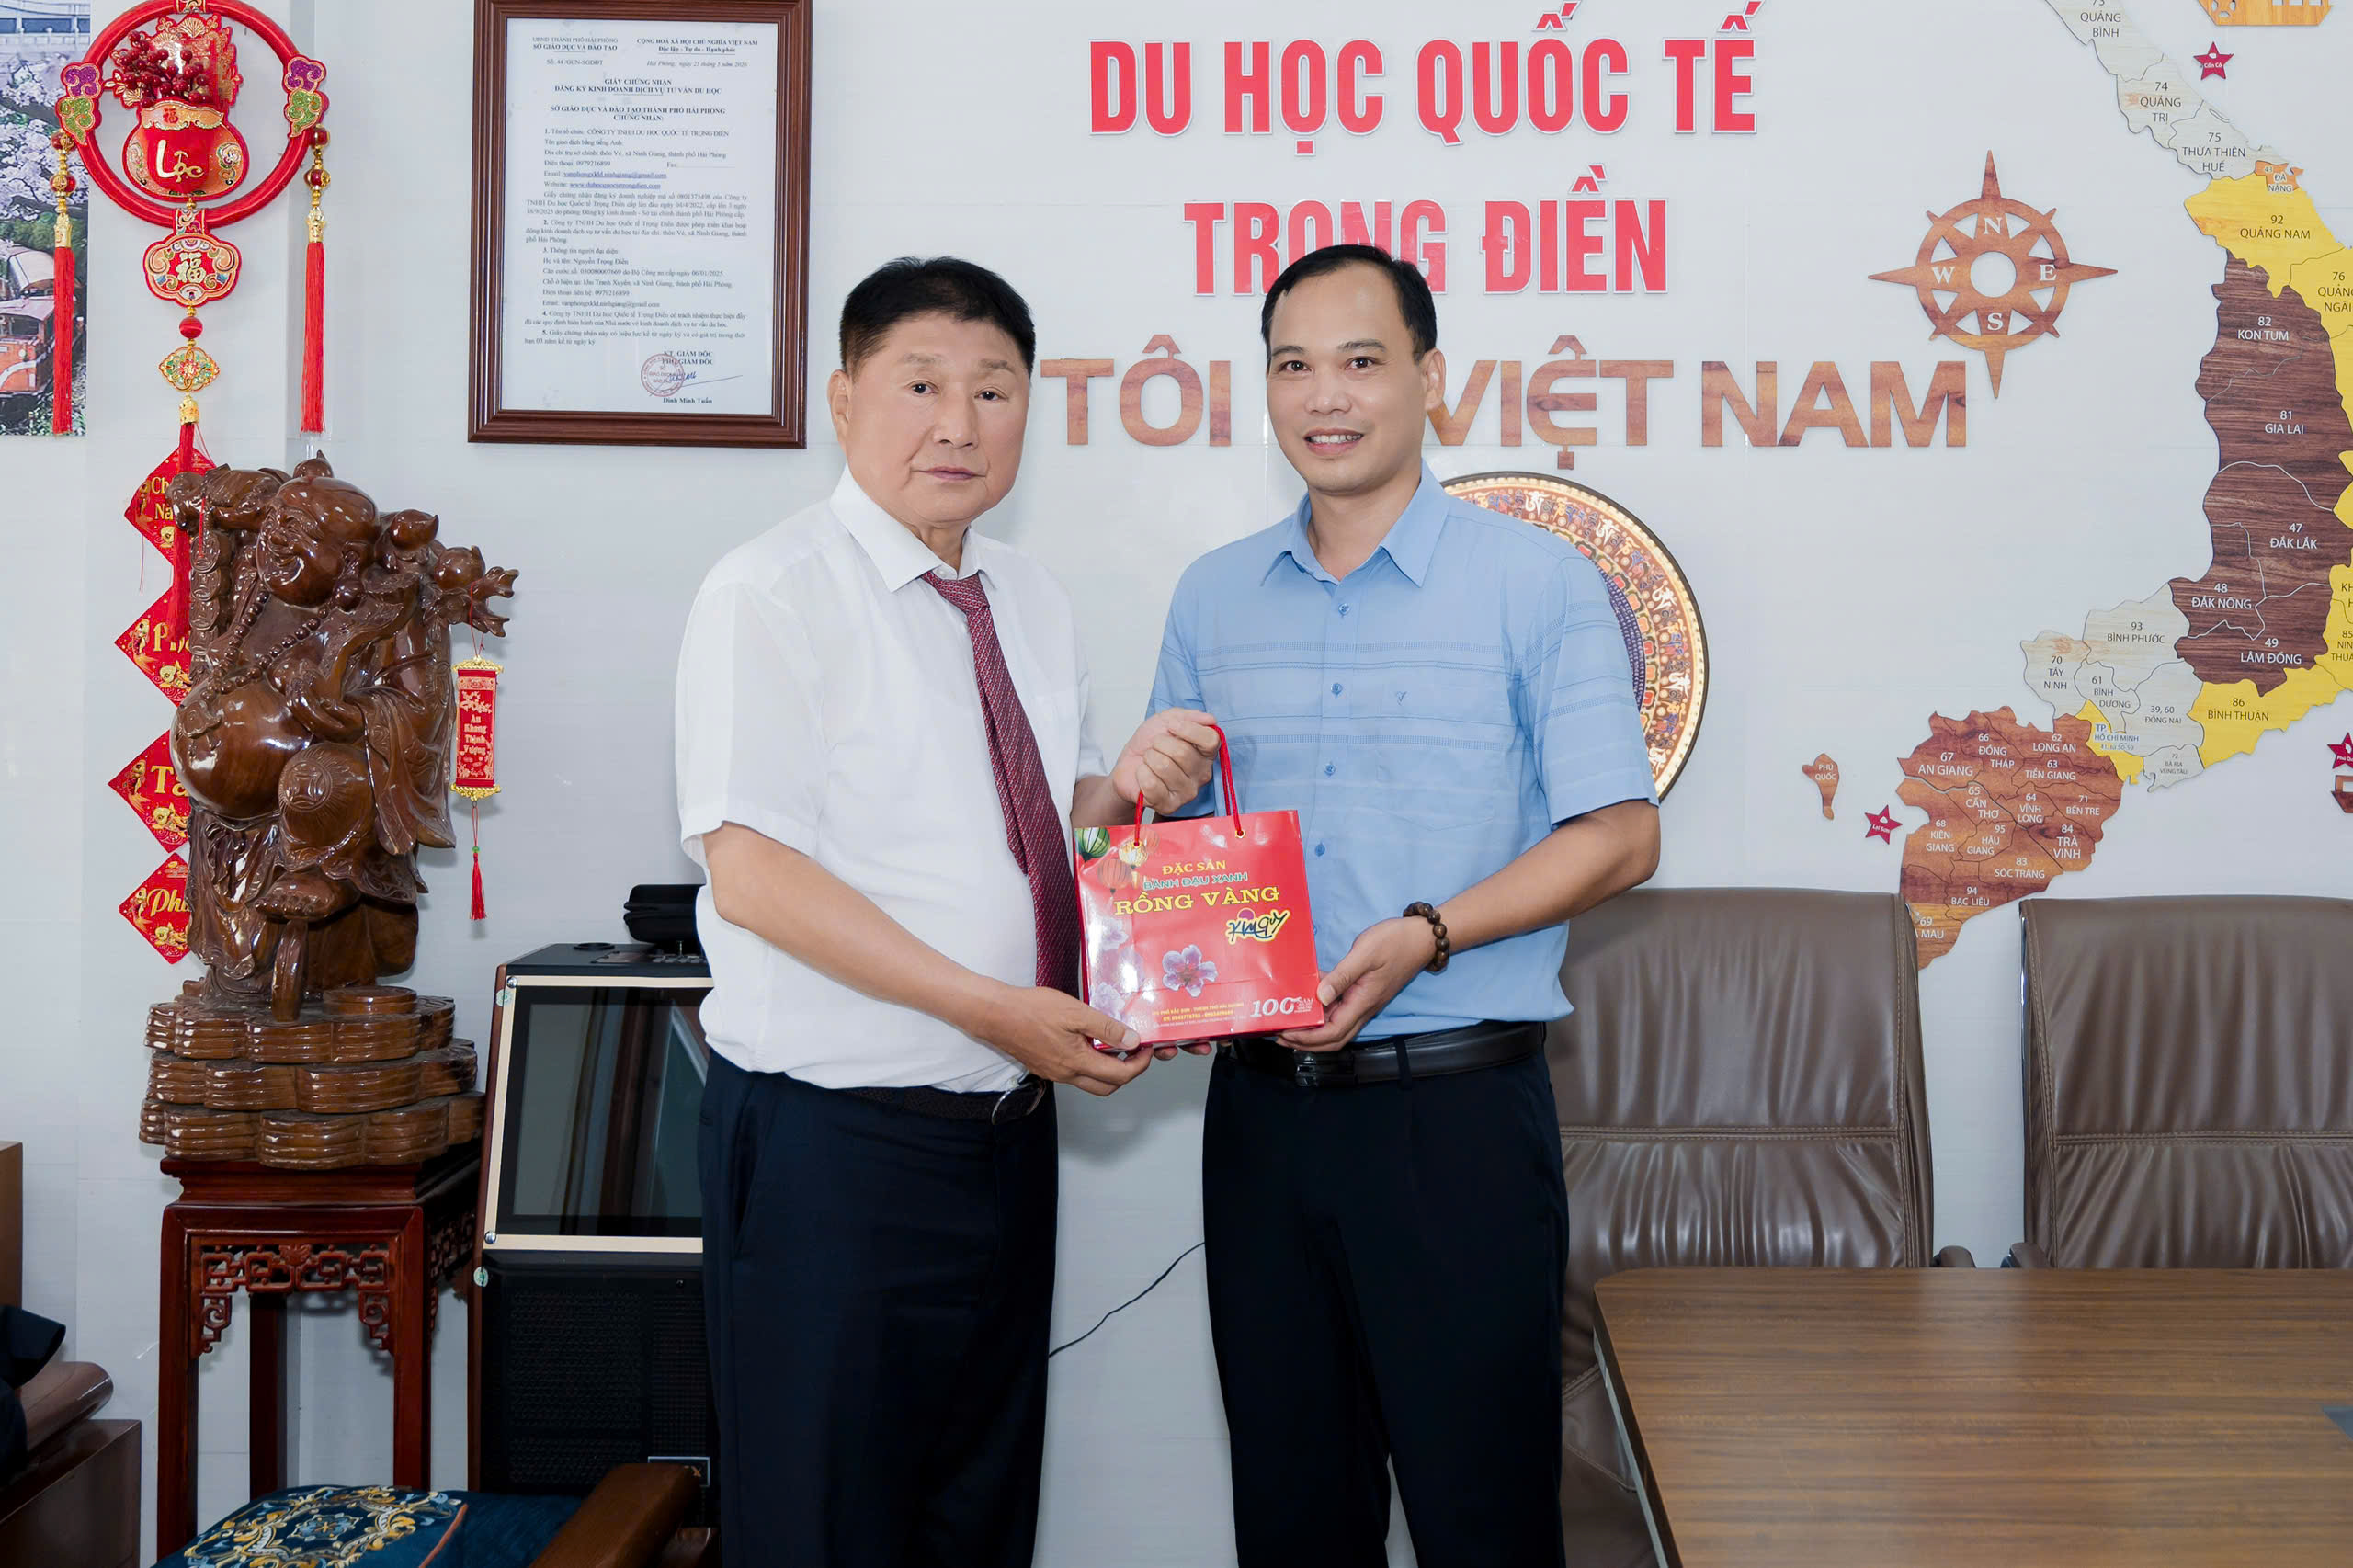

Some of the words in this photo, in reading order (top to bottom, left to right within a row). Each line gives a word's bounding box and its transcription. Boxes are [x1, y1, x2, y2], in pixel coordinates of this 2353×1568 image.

[2080, 10, 2122, 24] QUẢNG
[2092, 26, 2120, 39] BÌNH
[1088, 40, 1194, 137] DU
[1222, 38, 1385, 156] HỌC
[1415, 0, 1630, 146] QUỐC
[1663, 0, 1762, 134] TẾ
[2154, 81, 2168, 91] 74
[2140, 95, 2182, 108] QUẢNG
[2152, 111, 2169, 125] TRỊ
[2208, 132, 2222, 142] 75
[2182, 144, 2213, 157] THỪA
[2215, 145, 2246, 158] THIÊN
[156, 139, 204, 183] Lộc
[2202, 160, 2225, 172] HUẾ
[2270, 214, 2284, 225] 92
[1479, 164, 1669, 294] ĐIỀN
[1984, 217, 2004, 235] N
[2240, 225, 2281, 239] QUẢNG
[2284, 229, 2311, 240] NAM
[175, 253, 208, 284] 福
[2038, 263, 2058, 282] E
[1931, 266, 1956, 285] W
[2332, 271, 2346, 282] 76
[2324, 300, 2353, 313] NGÃI
[1986, 312, 2005, 331] S
[2257, 316, 2273, 327] 82
[2237, 329, 2262, 341] KON
[2264, 330, 2290, 342] TUM
[1040, 334, 1232, 448] TÔI
[1426, 334, 1675, 471] VIỆT
[1701, 359, 1967, 449] NAM
[2279, 410, 2293, 420] 81
[2264, 423, 2284, 435] GIA
[2287, 424, 2305, 435] LAI
[151, 476, 171, 495] Ch
[2289, 523, 2303, 533] 47
[2213, 583, 2229, 593] 48
[2217, 596, 2252, 610] NÔNG
[2131, 621, 2143, 631] 93
[2107, 631, 2130, 642] BÌNH
[2131, 631, 2165, 644] PHƯỚC
[2341, 630, 2353, 639] 85
[2264, 638, 2279, 648] 49
[2051, 655, 2063, 665] 70
[2240, 651, 2265, 664] LÂM
[2267, 651, 2302, 665] ĐỒNG
[2048, 666, 2065, 677] TÂY
[2043, 681, 2068, 690] NINH
[2091, 676, 2103, 685] 61
[2094, 687, 2114, 697] BÌNH
[2098, 699, 2131, 710] DƯƠNG
[2232, 698, 2245, 708] 86
[2150, 705, 2163, 716] 39,
[2164, 705, 2176, 715] 60
[2207, 708, 2233, 721] BÌNH
[2234, 709, 2270, 722] THUẬN
[2144, 715, 2168, 725] ĐỒNG
[2169, 717, 2182, 725] NAI
[1978, 733, 1990, 743] 66
[2052, 733, 2063, 743] 62
[2120, 734, 2140, 743] MINH
[1978, 744, 2008, 756] ĐỒNG
[2032, 743, 2060, 753] LONG
[2062, 744, 2077, 754] AN
[1940, 752, 1955, 763] 67
[1990, 756, 2016, 769] THÁP
[2046, 760, 2059, 769] 63
[1917, 765, 1936, 776] AN
[1937, 766, 1974, 777] GIANG
[2025, 767, 2045, 779] TIỀN
[2046, 770, 2076, 781] GIANG
[1968, 786, 1981, 796] 65
[2025, 792, 2037, 802] 64
[1965, 796, 1987, 809] CẦN
[2078, 795, 2089, 804] 71
[2019, 801, 2042, 814] VĨNH
[2065, 803, 2084, 816] BẾN
[2085, 807, 2100, 817] TRE
[1977, 808, 2000, 820] THƠ
[2018, 813, 2044, 824] LONG
[1935, 819, 1947, 829] 68
[1995, 824, 2006, 834] 95
[2061, 824, 2075, 834] 84
[1930, 828, 1951, 840] KIÊN
[1981, 835, 2001, 847] HẬU
[2056, 835, 2079, 848] TRÀ
[1926, 843, 1956, 854] GIANG
[1966, 846, 1995, 856] GIANG
[2052, 848, 2082, 859] VINH
[1161, 861, 1194, 876] ĐẶC
[1196, 858, 1227, 872] SẢN
[2015, 857, 2029, 867] 83
[1211, 871, 1250, 884] XANH
[1995, 866, 2014, 879] SÓC
[2014, 867, 2046, 880] TRĂNG
[1966, 886, 1979, 896] 94
[1113, 890, 1195, 917] RỒNG
[1200, 885, 1281, 909] VÀNG
[1949, 896, 1970, 908] BẠC
[1971, 895, 1990, 907] LIÊU
[1919, 916, 1933, 926] 69
[1921, 929, 1945, 940] MAU
[1250, 996, 1300, 1018] 100
